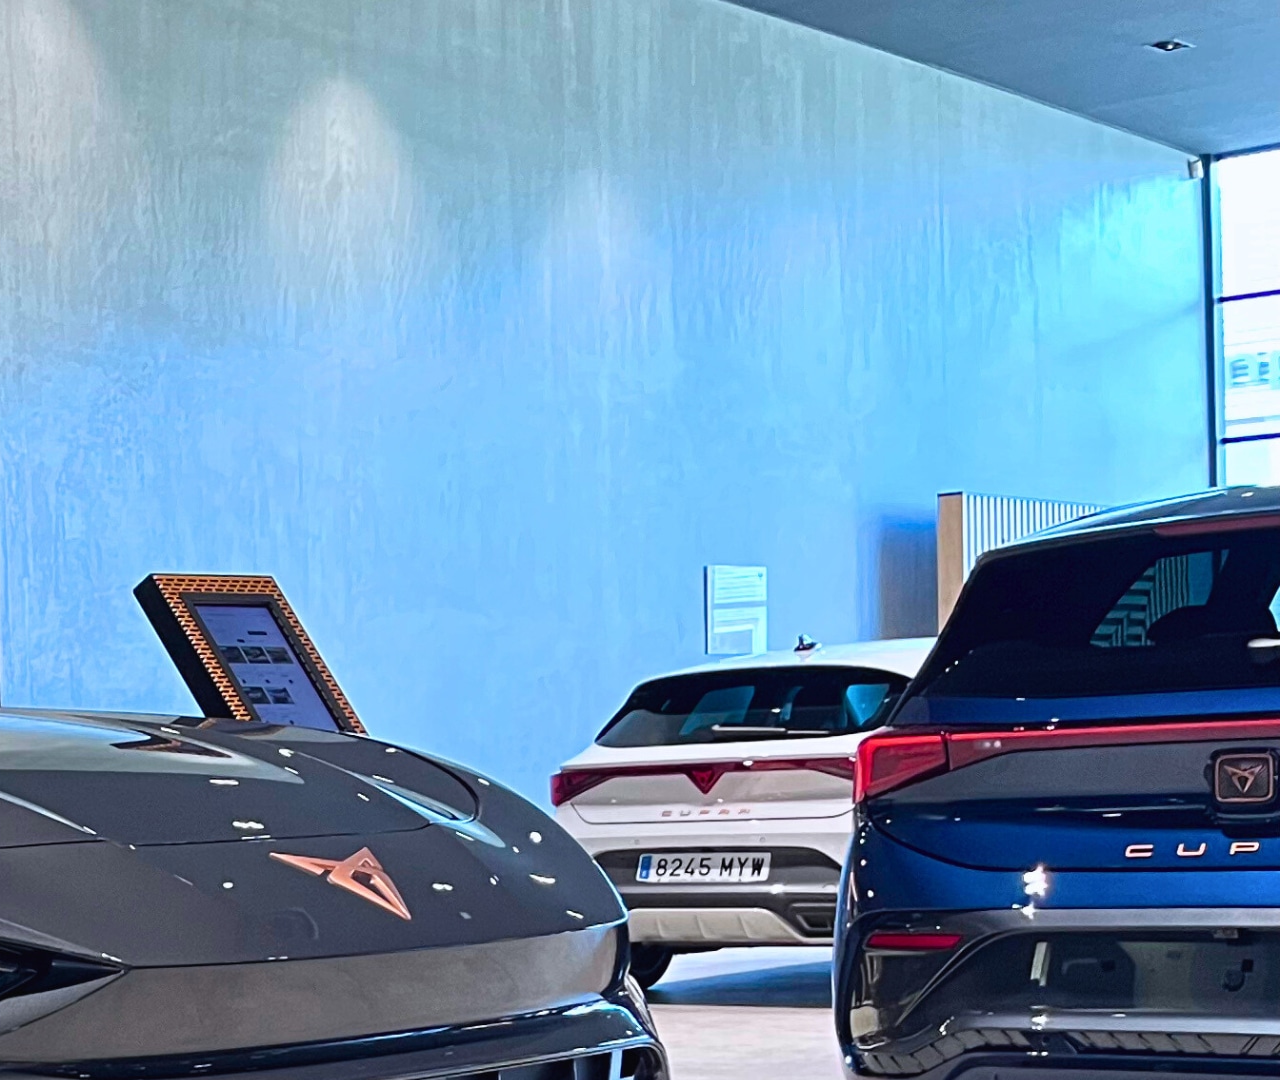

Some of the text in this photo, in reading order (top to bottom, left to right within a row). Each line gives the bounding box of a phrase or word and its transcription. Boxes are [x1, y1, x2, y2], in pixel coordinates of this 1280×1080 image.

[1125, 841, 1260, 859] CUP
[656, 857, 764, 876] 8245 MYW
